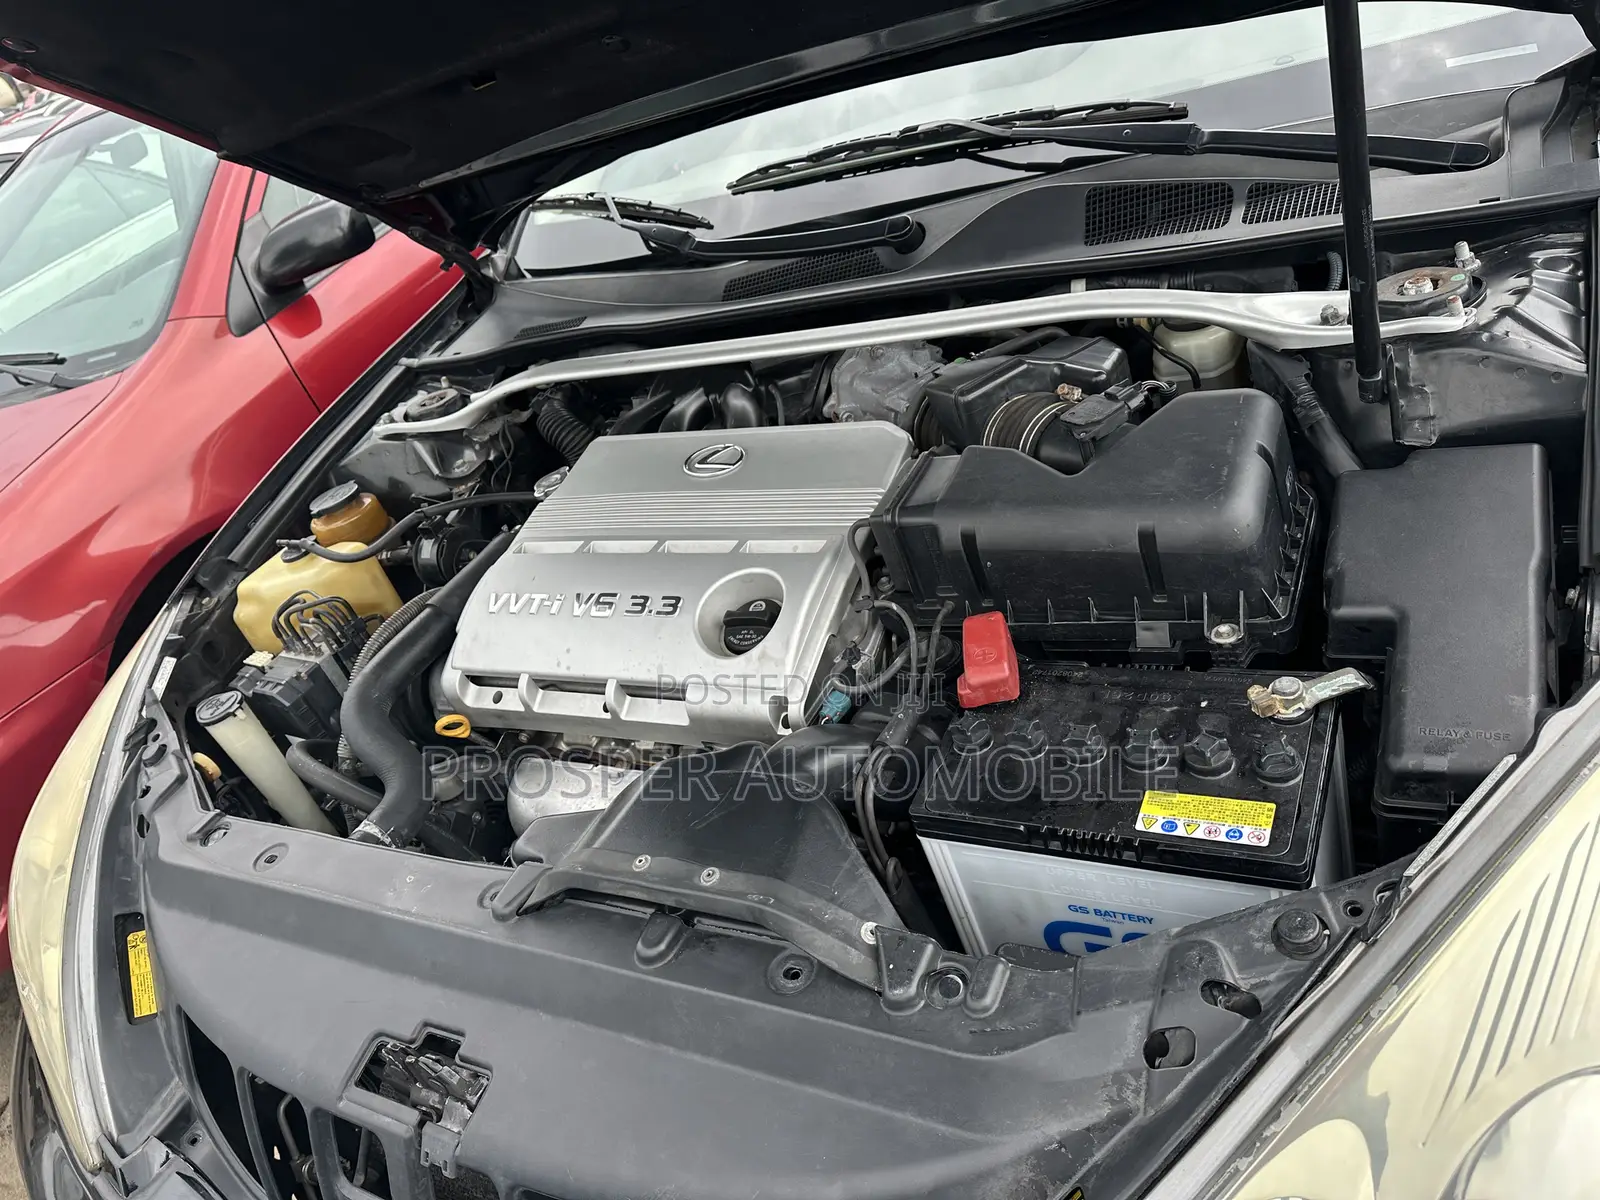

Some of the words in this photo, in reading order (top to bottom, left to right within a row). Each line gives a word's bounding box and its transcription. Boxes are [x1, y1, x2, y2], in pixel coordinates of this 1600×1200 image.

[488, 592, 566, 615] VVT-i
[572, 592, 621, 618] V6
[624, 594, 685, 618] 3.3
[1418, 727, 1460, 738] RELAY
[1463, 730, 1473, 739] &
[1476, 731, 1512, 741] FUSE
[1046, 866, 1099, 882] UPPER
[1105, 873, 1157, 890] LEVEL
[1050, 884, 1104, 900] LOWER
[1112, 893, 1163, 909] LEVEL
[1067, 904, 1090, 915] GS
[1093, 908, 1154, 925] BATTERY
[1043, 920, 1149, 953] G
